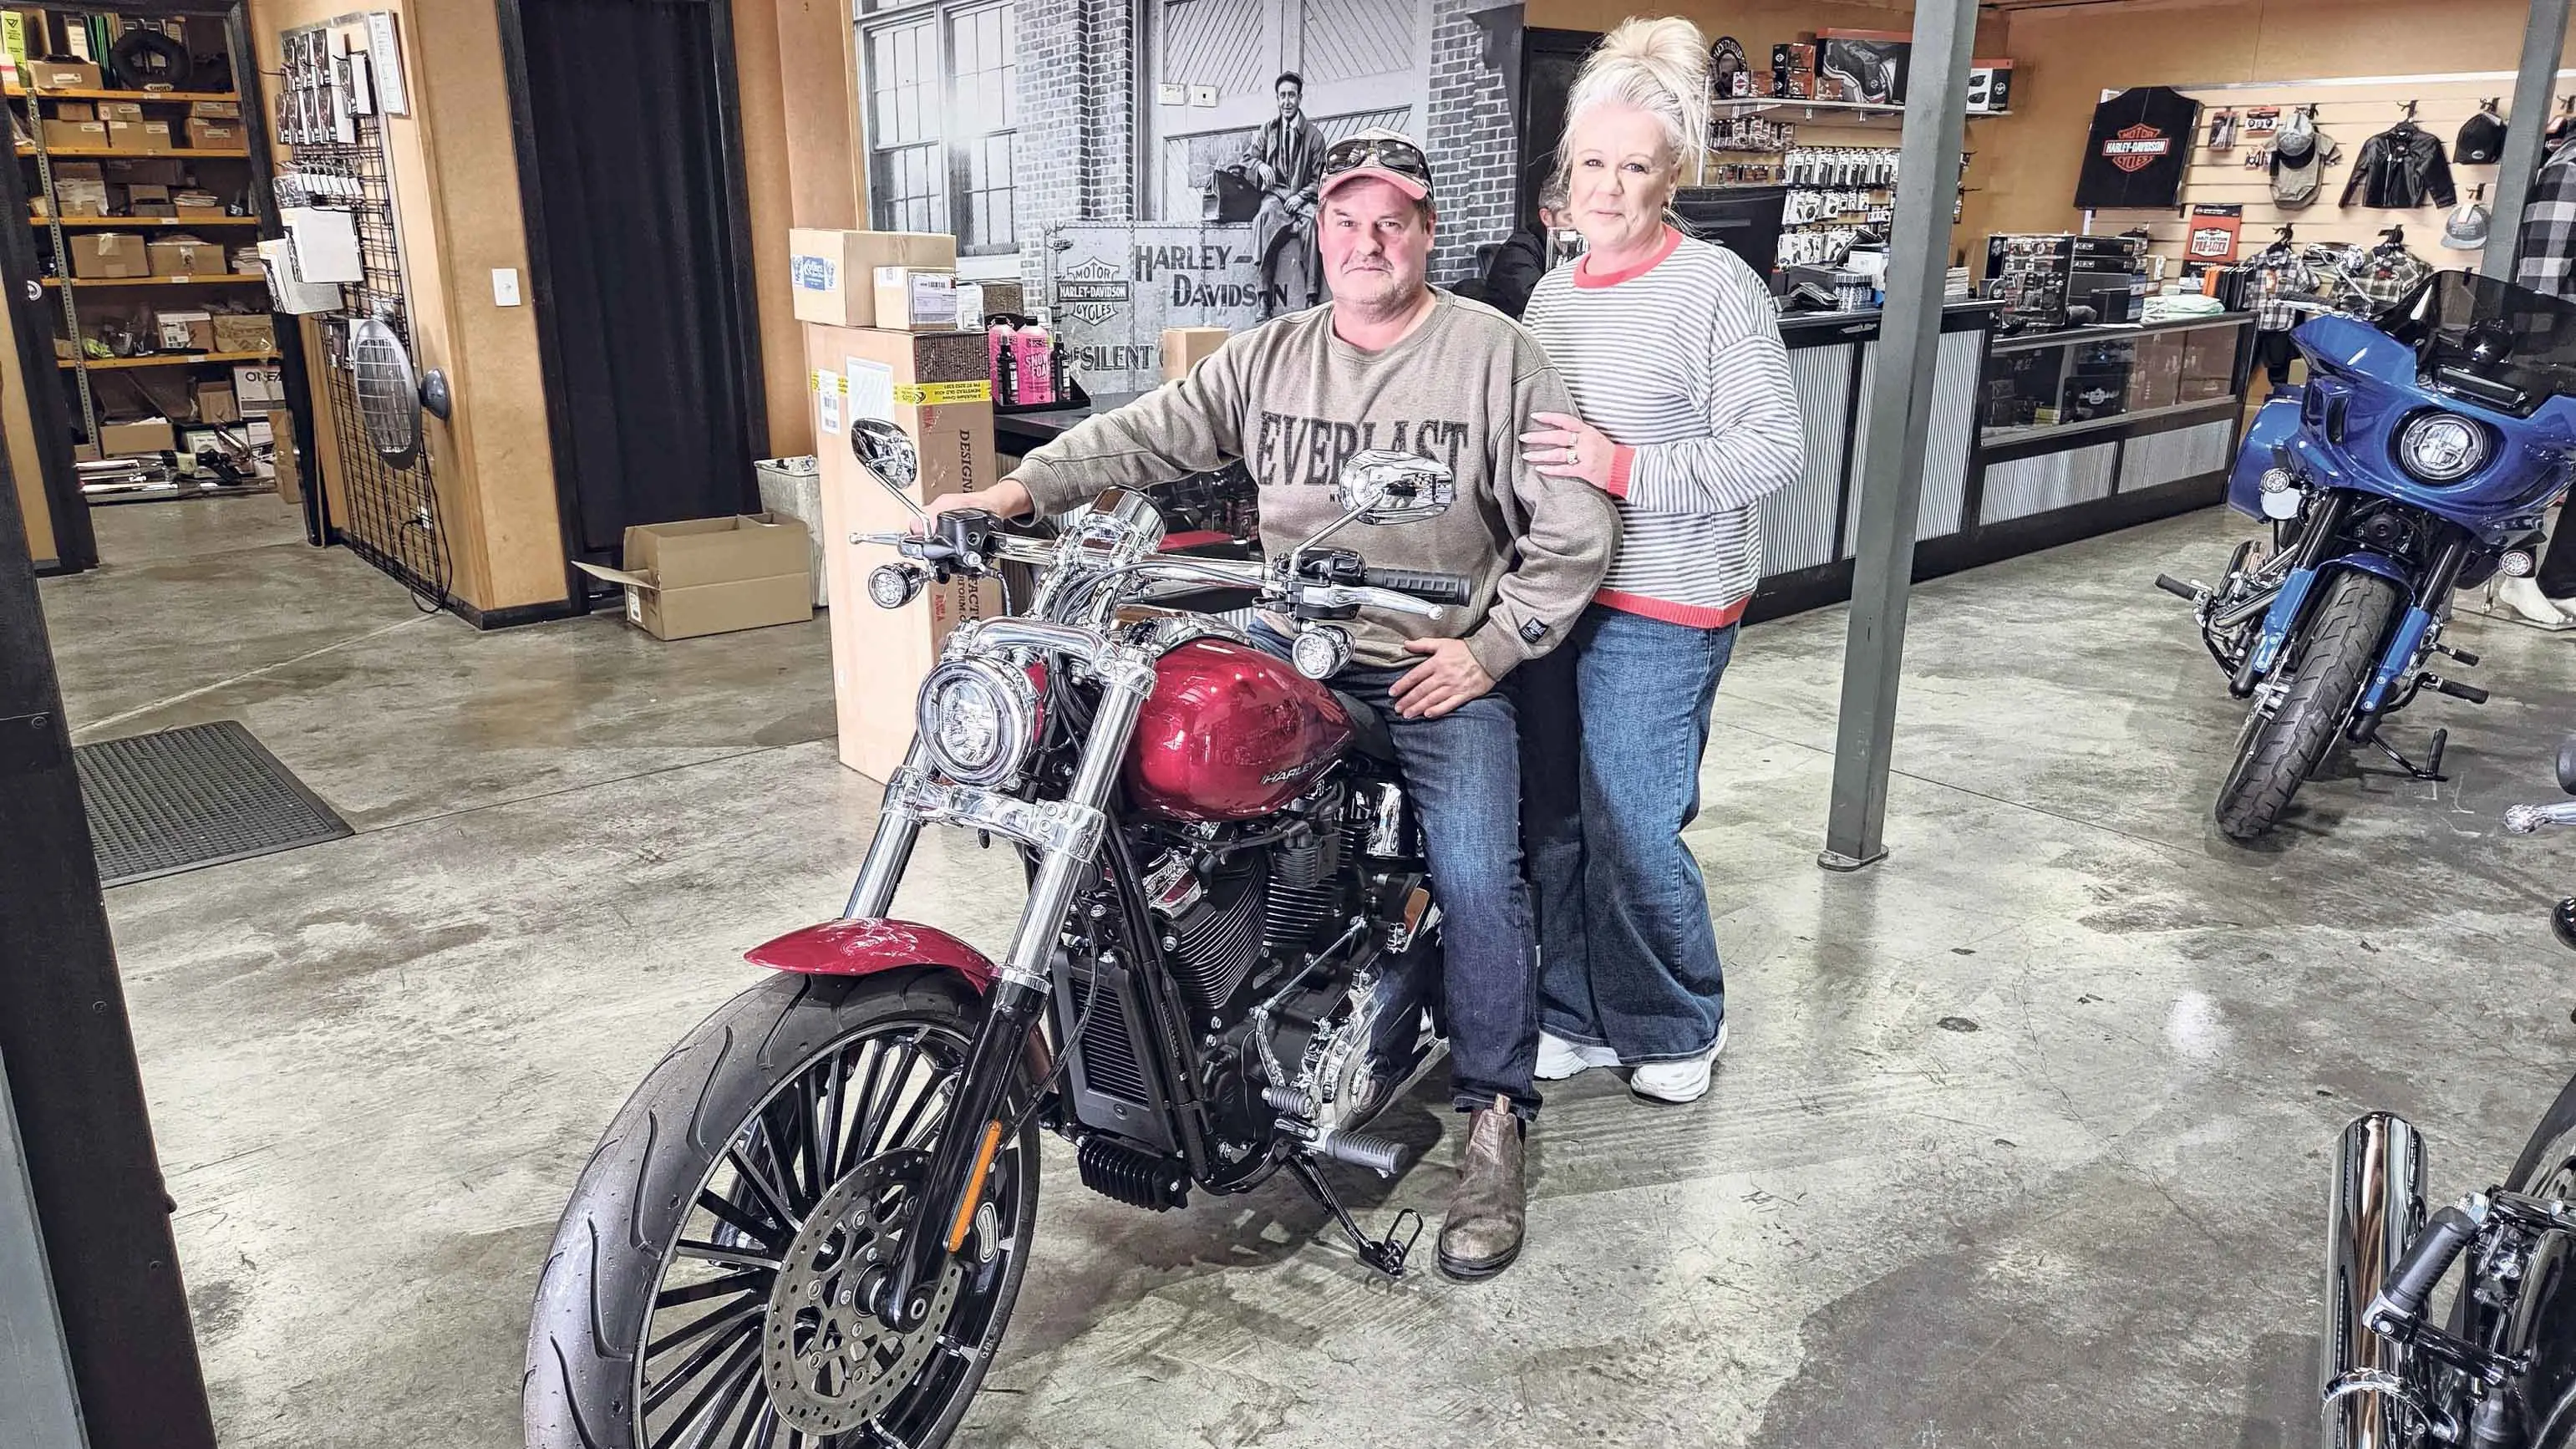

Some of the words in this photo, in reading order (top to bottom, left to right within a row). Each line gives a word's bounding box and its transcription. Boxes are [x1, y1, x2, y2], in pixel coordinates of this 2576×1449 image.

[2121, 128, 2154, 140] MOTOR
[2106, 140, 2166, 154] HARLEY-DAVIDSON
[2116, 155, 2148, 168] CYCLES
[1075, 259, 1110, 280] MOTOR
[1059, 284, 1127, 299] HARLEY-DAVIDSON
[1173, 274, 1288, 308] DAVIDSN
[1076, 303, 1111, 321] CYCLES
[1080, 344, 1154, 371] SILENT
[959, 429, 974, 493] DESIGN
